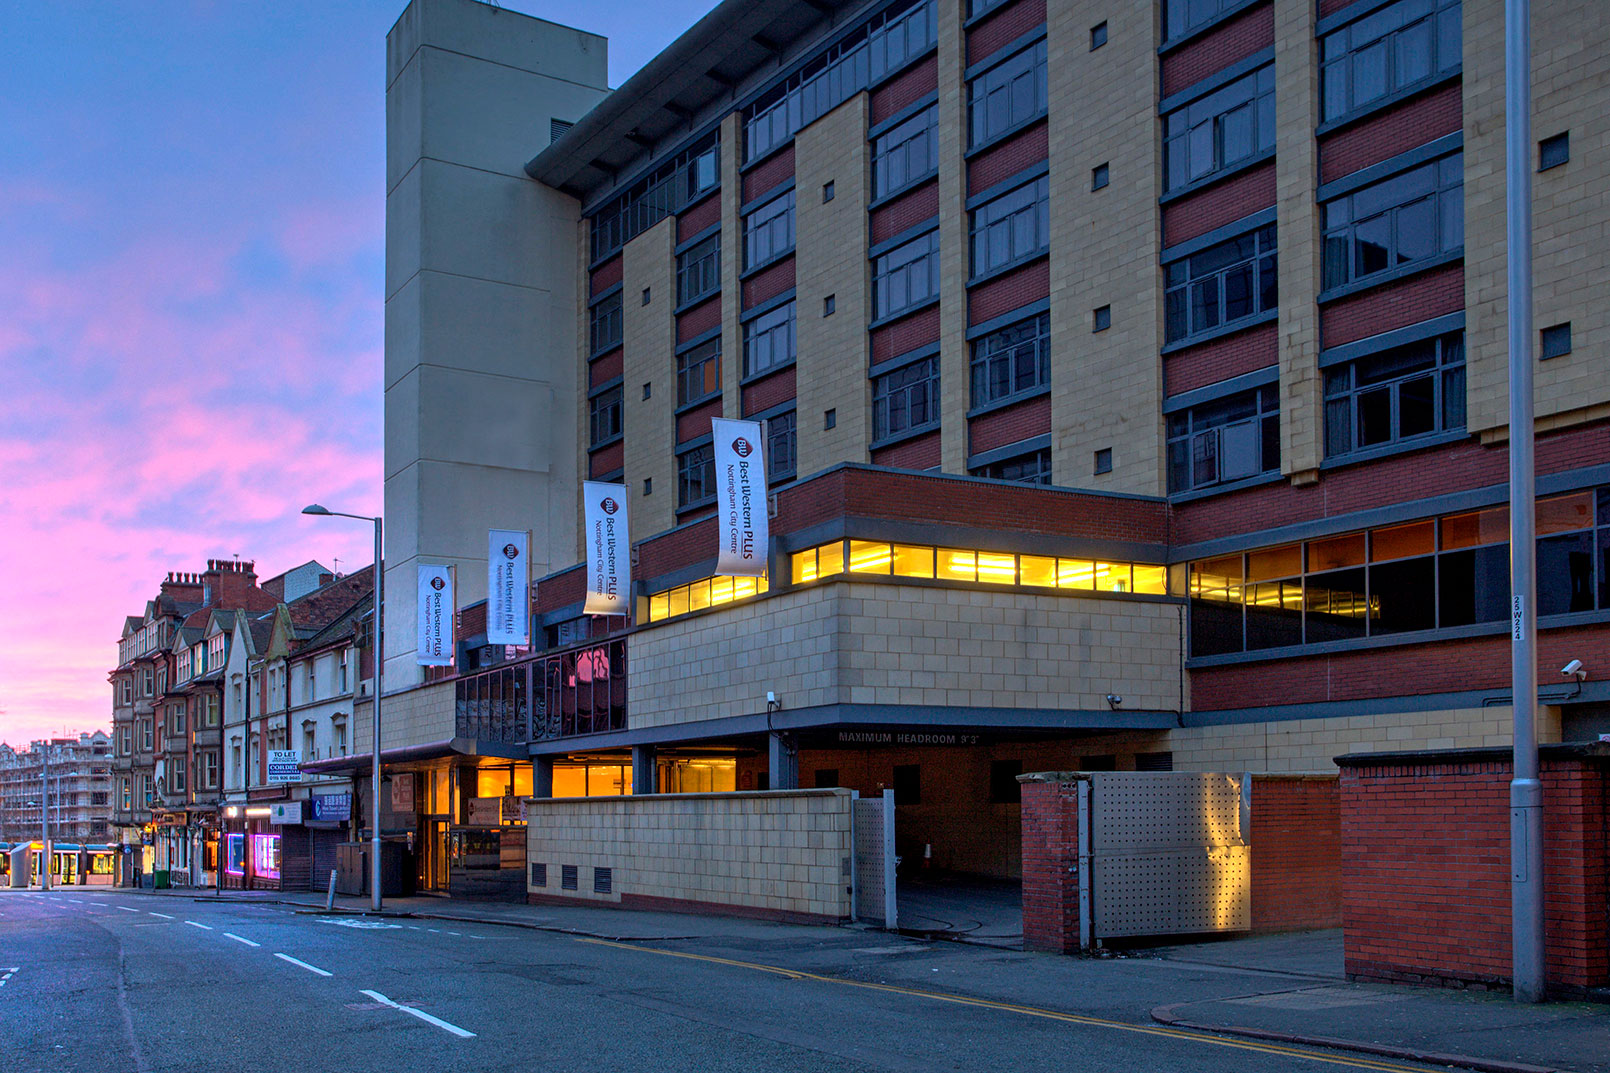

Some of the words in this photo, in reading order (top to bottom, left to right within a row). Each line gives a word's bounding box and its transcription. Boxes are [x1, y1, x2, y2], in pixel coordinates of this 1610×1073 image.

[740, 461, 750, 483] Best
[727, 464, 737, 510] Nottingham
[729, 511, 737, 526] City
[741, 485, 752, 529] Western
[595, 520, 603, 558] Nottingham
[606, 518, 614, 536] Best
[730, 528, 738, 554] Centre
[743, 530, 753, 560] PLUS
[596, 559, 604, 573] City
[608, 538, 616, 574] Western
[506, 562, 514, 578] Best
[506, 580, 514, 612] Western
[608, 577, 617, 601] PLUS
[505, 614, 513, 634] PLUS
[839, 732, 891, 742] MAXIMUM
[898, 734, 955, 743] HEADROOM
